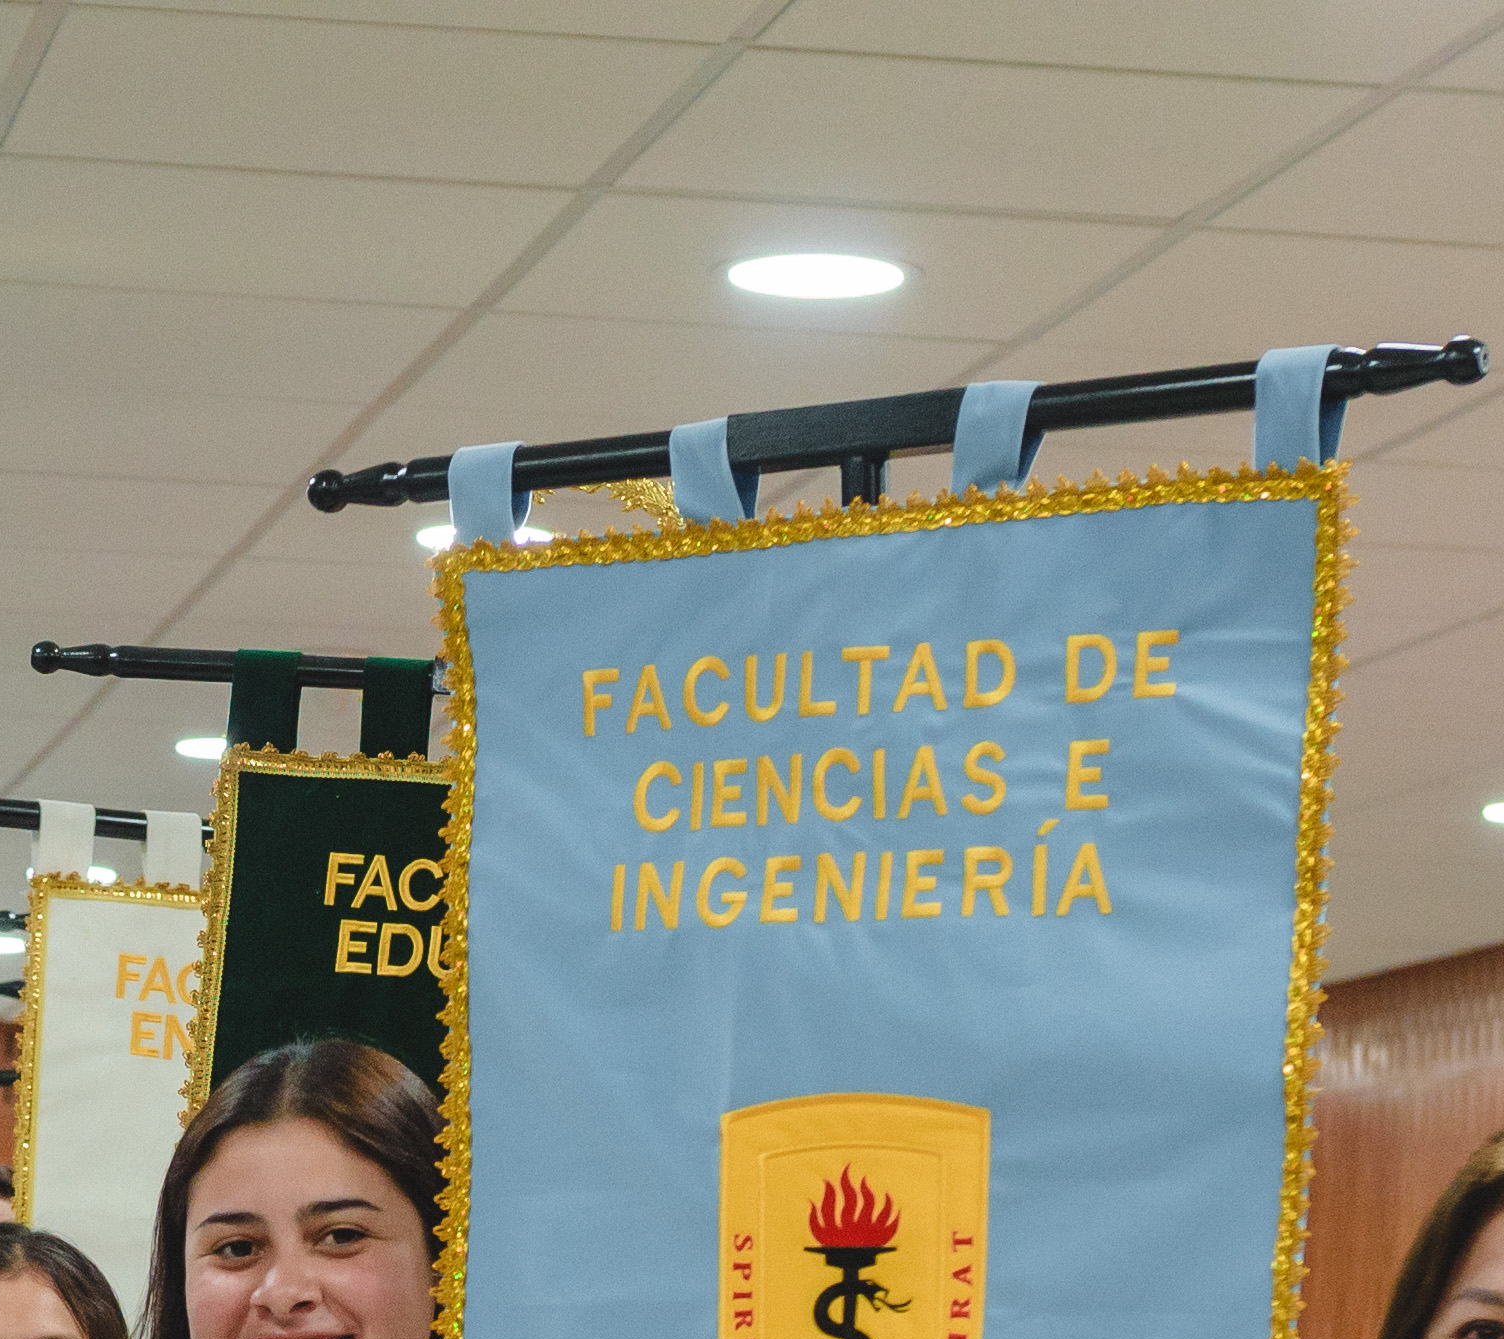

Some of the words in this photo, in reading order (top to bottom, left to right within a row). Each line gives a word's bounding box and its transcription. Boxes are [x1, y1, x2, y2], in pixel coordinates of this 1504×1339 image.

[582, 638, 1017, 736] FACULTAD
[1065, 629, 1180, 704] DE
[633, 740, 1008, 832] CIENCIAS
[1065, 738, 1110, 811] E
[611, 818, 1113, 931] INGENIERÍA
